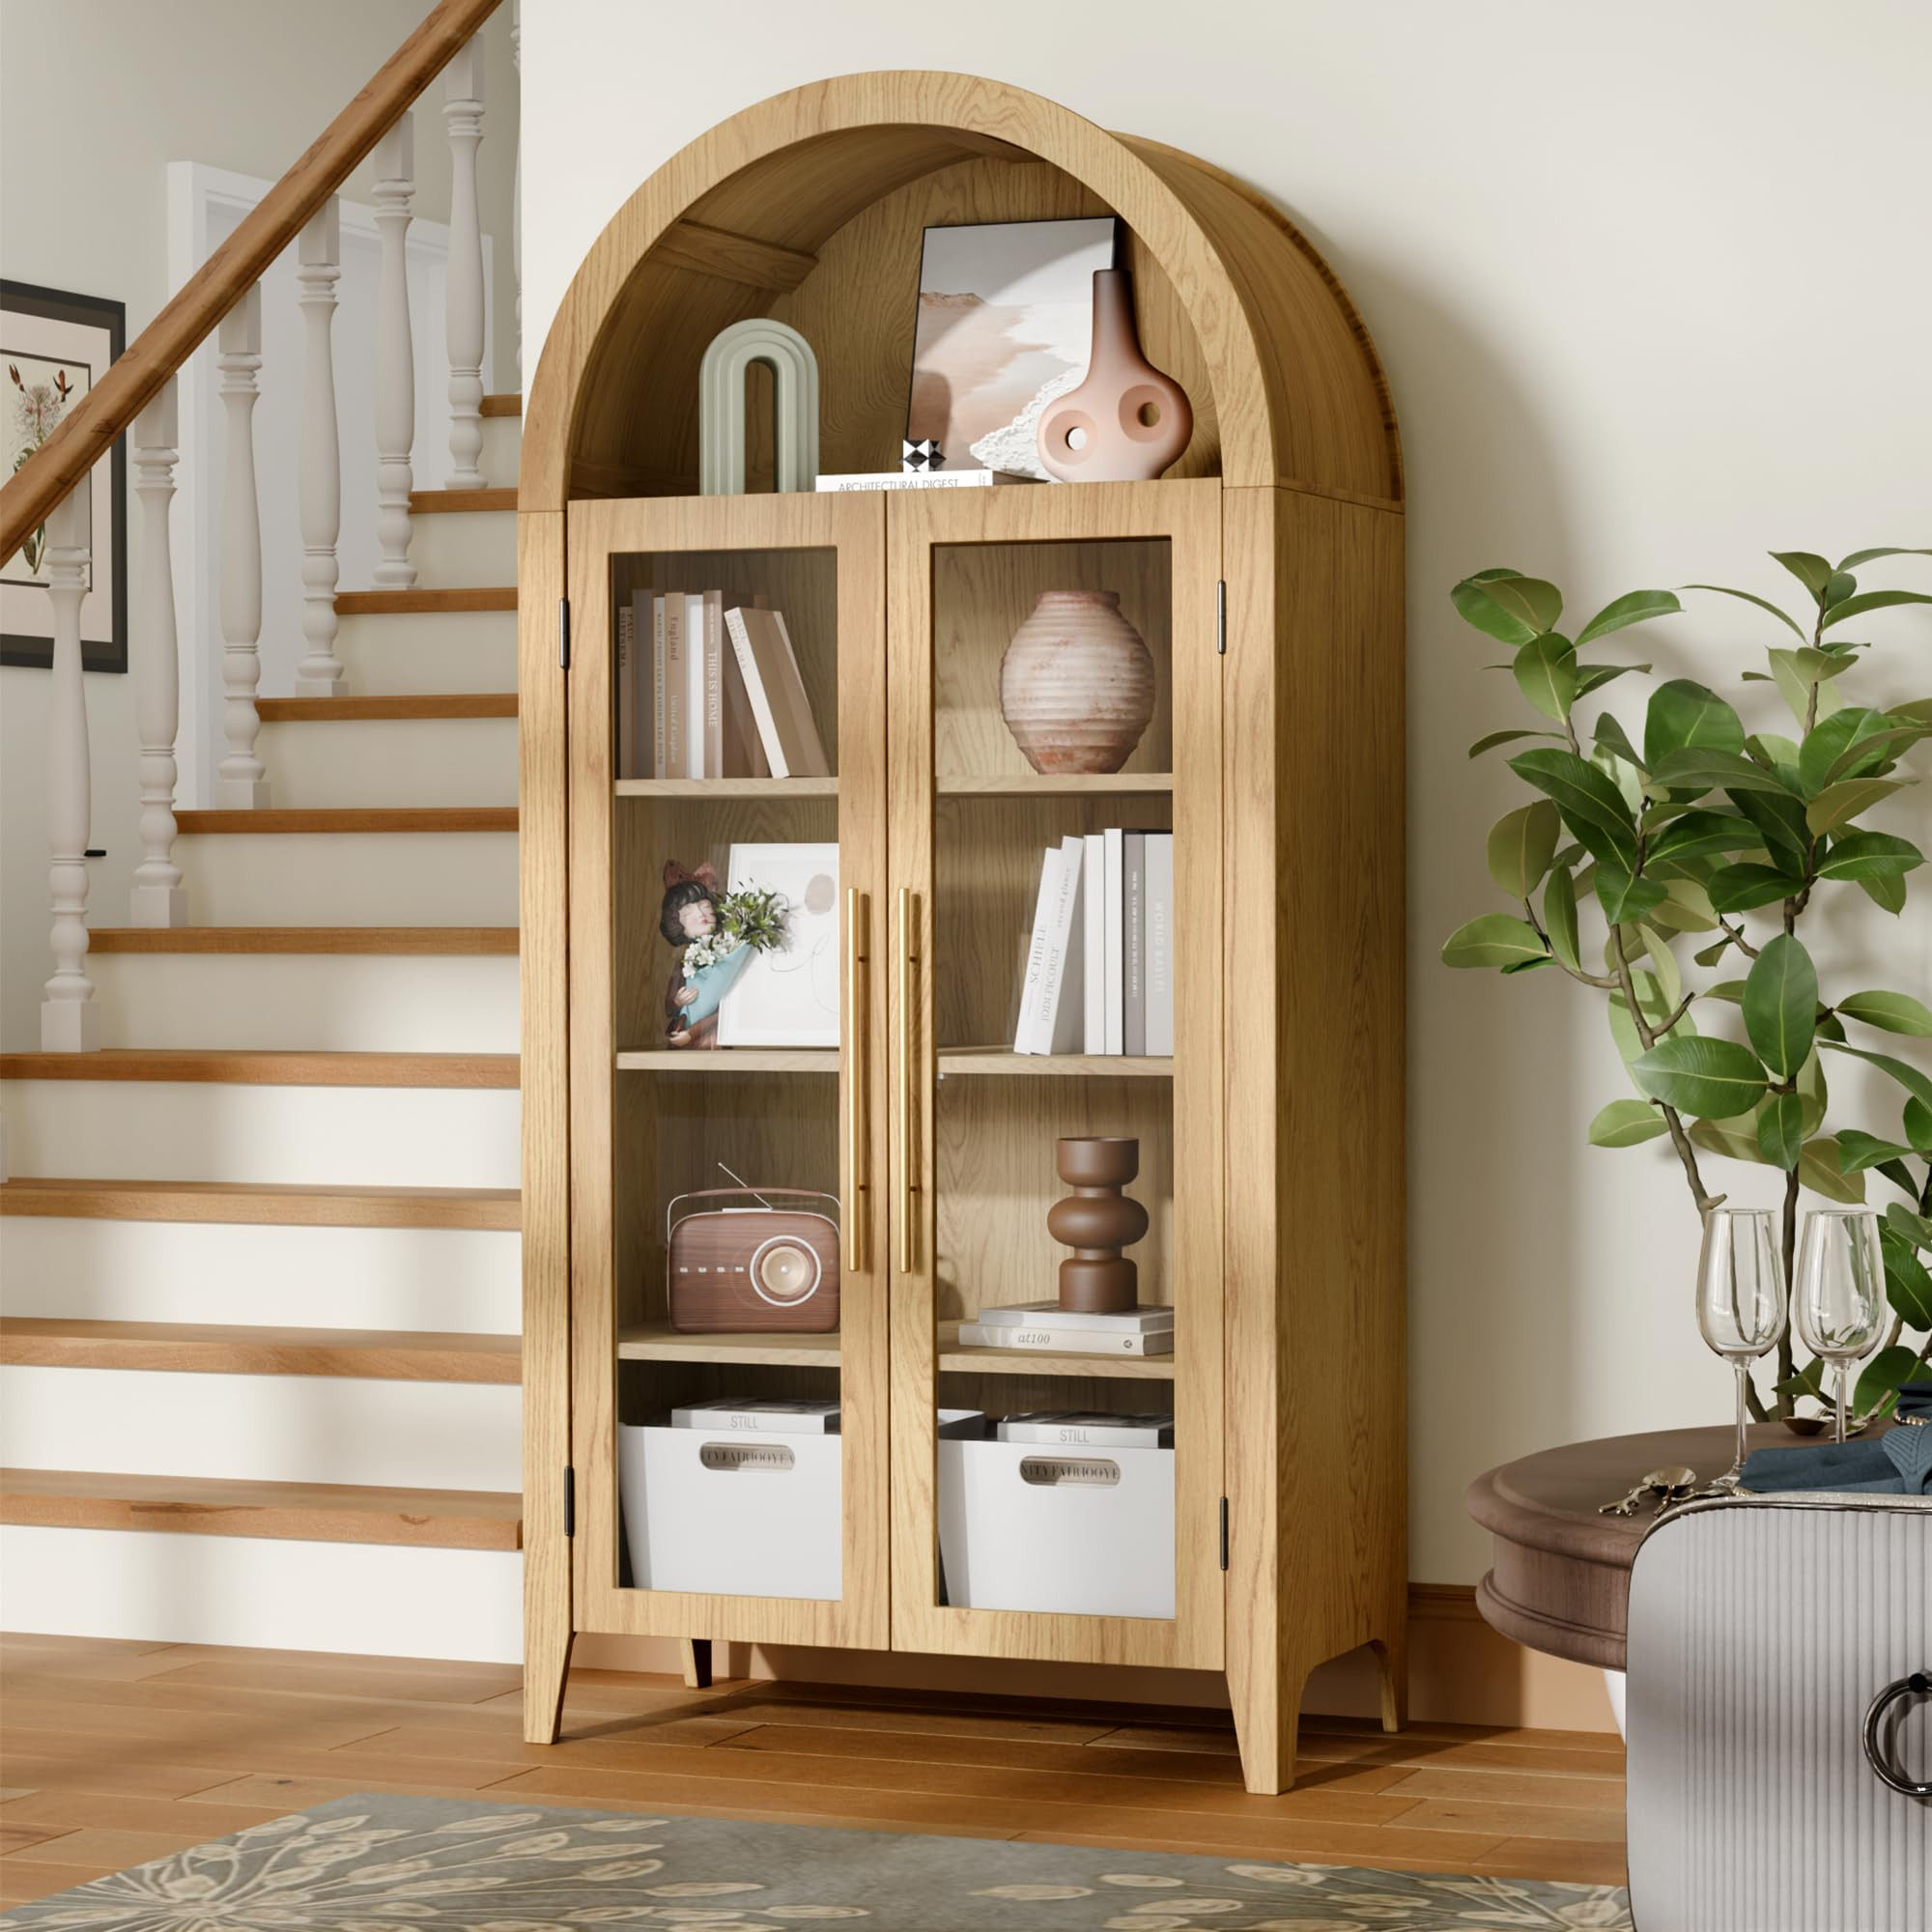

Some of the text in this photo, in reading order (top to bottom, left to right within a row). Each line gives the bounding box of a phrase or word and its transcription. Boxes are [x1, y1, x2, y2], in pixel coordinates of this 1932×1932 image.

[838, 478, 959, 491] ARCHITECTURAL DIGEST
[707, 650, 718, 677] THIS
[707, 693, 718, 727] HOME
[730, 1414, 758, 1430] STILL
[1060, 1429, 1090, 1443] STILL
